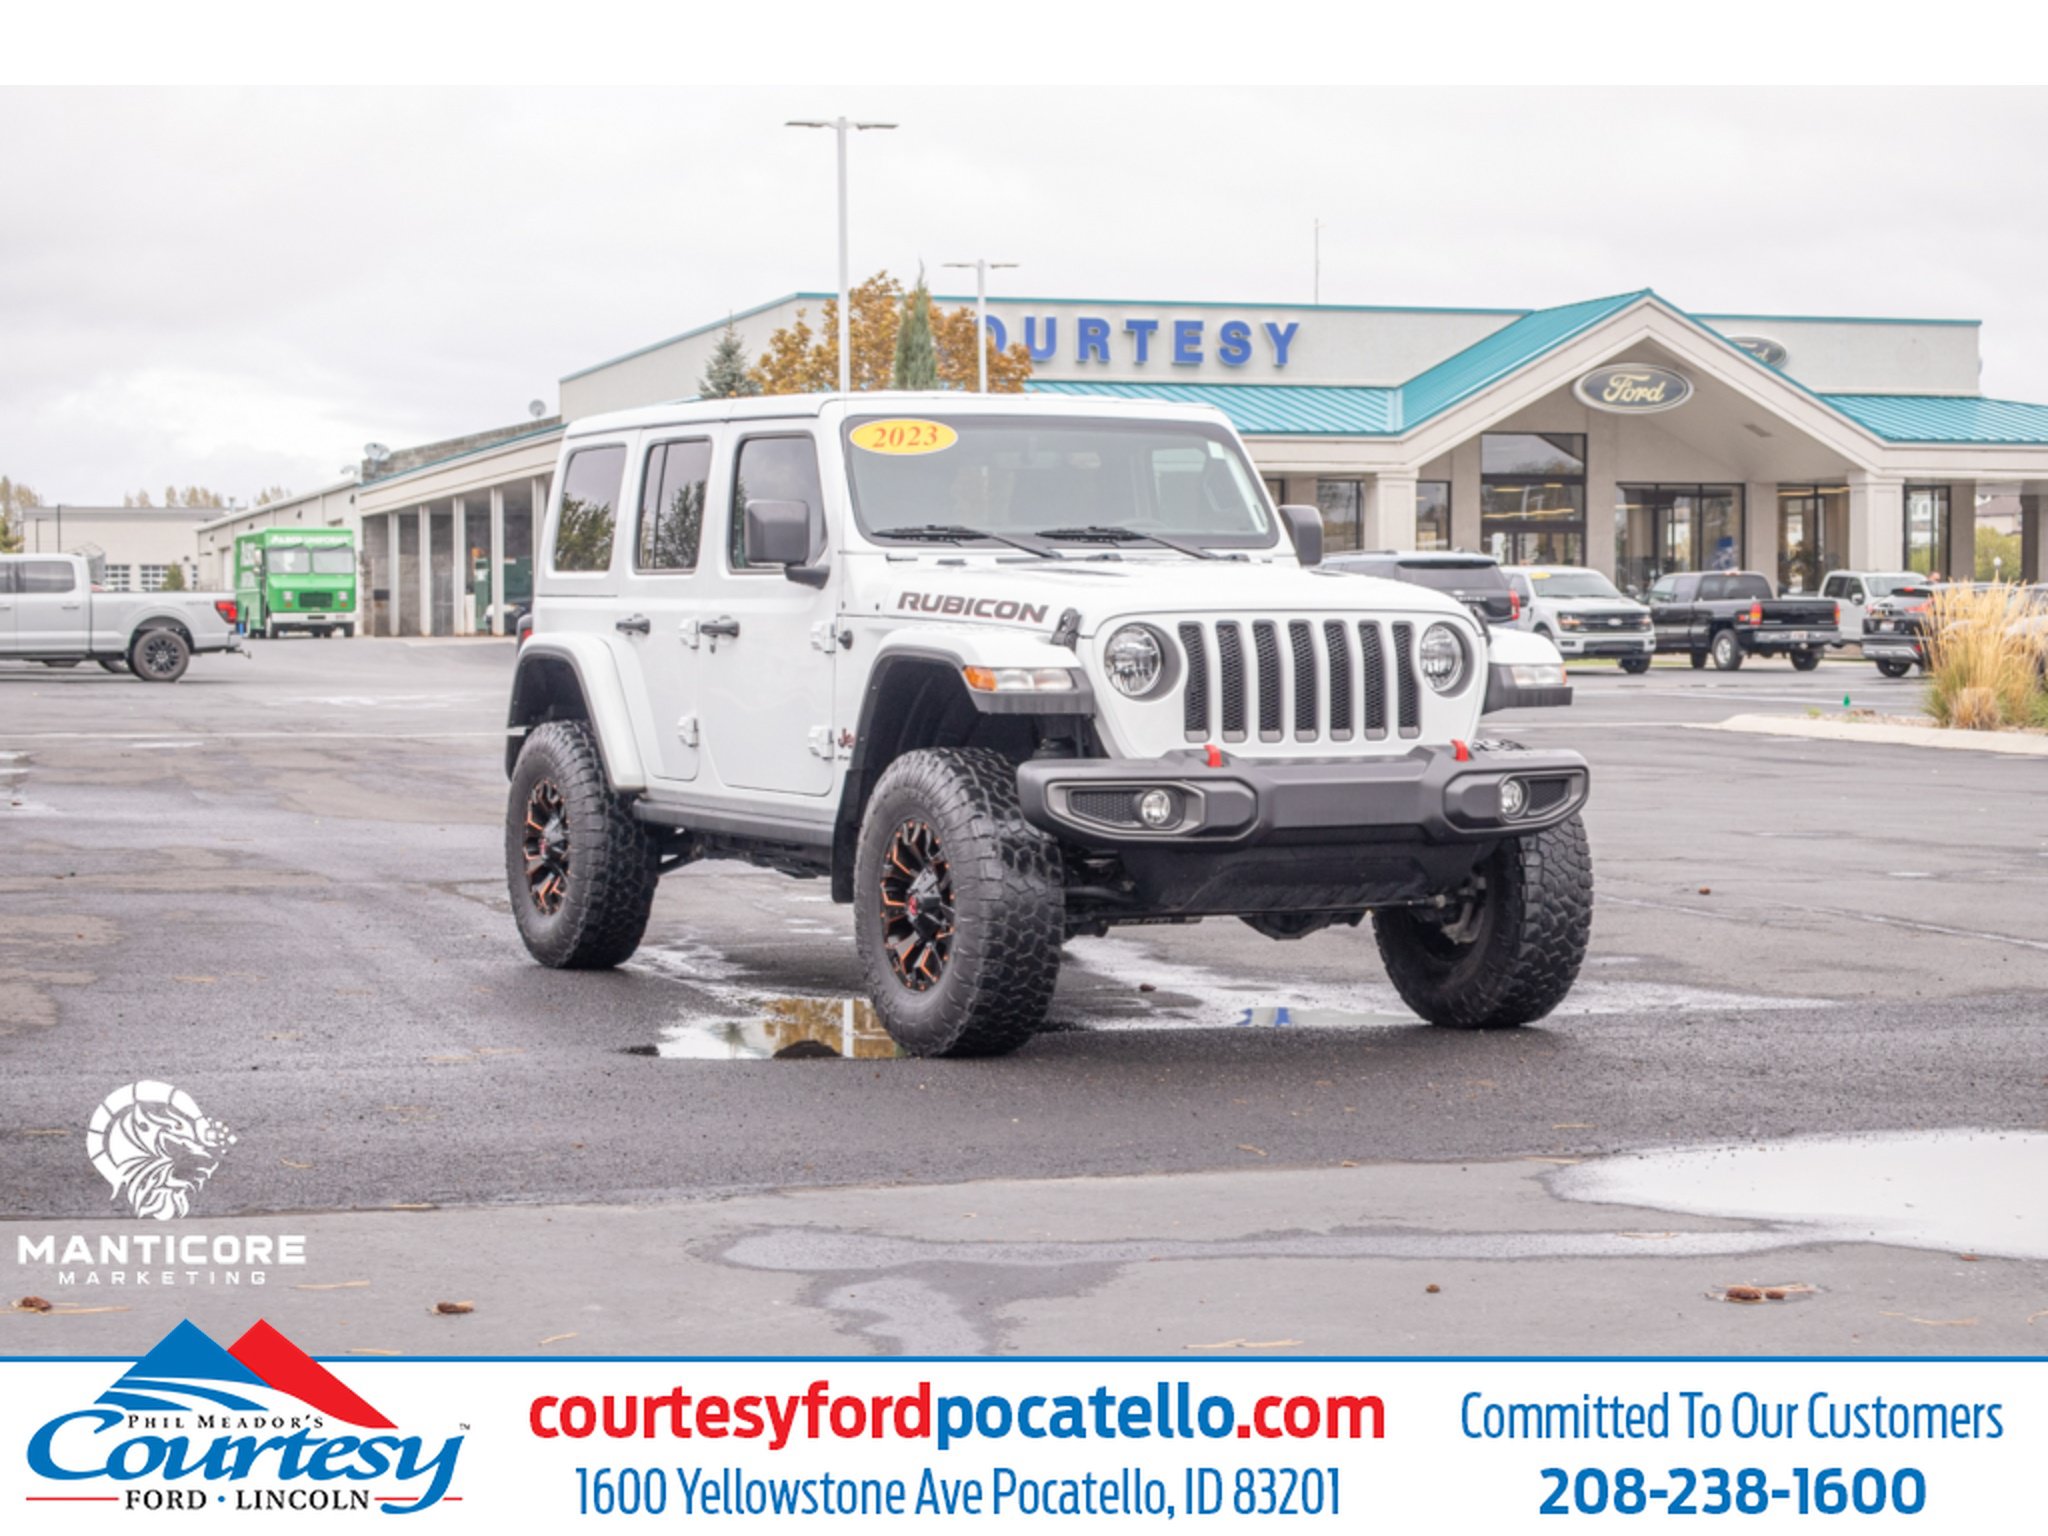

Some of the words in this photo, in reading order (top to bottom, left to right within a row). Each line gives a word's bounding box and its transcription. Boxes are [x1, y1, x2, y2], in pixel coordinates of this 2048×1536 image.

[974, 314, 1299, 366] OURTESY
[1603, 373, 1666, 402] Ford
[872, 425, 938, 448] 2023
[897, 591, 1049, 624] RUBICON
